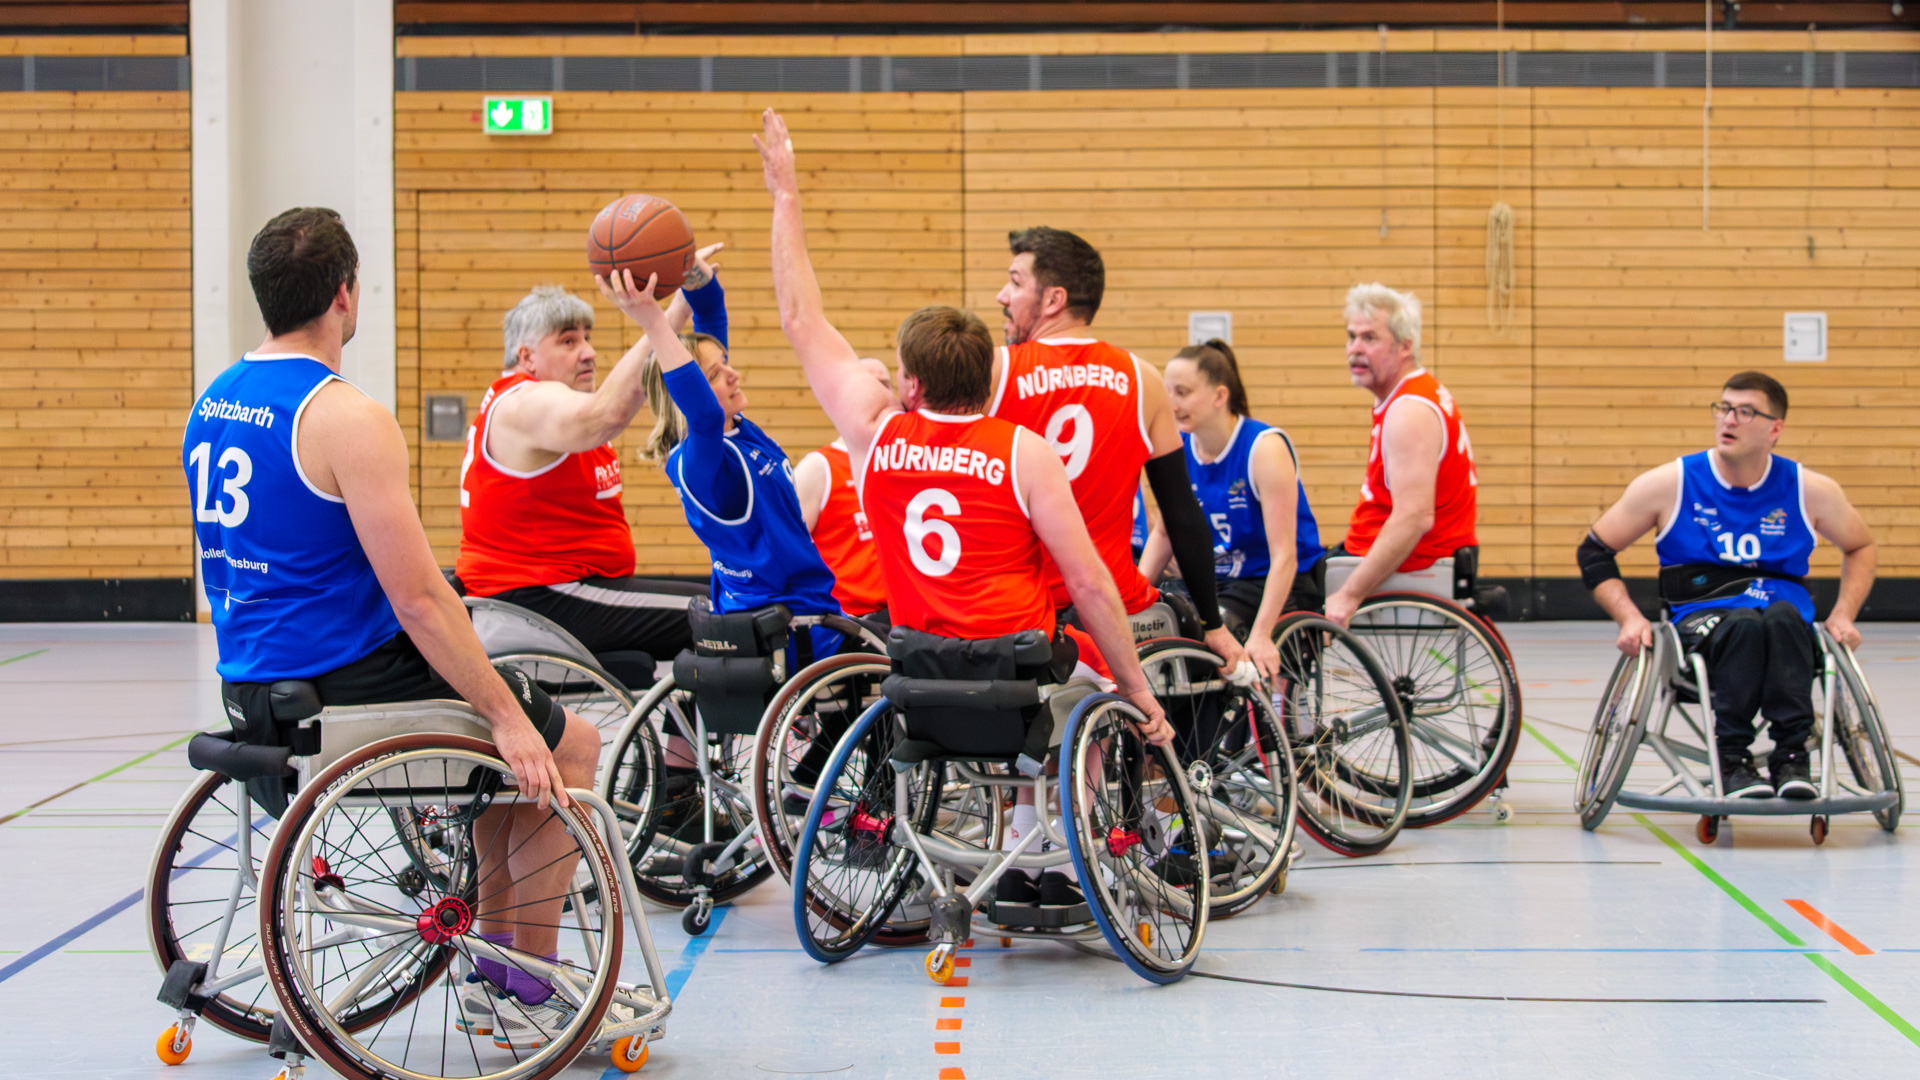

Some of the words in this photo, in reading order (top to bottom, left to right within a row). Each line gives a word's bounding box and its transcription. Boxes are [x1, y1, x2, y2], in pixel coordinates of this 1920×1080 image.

[1016, 362, 1130, 400] NÜRNBERG
[198, 396, 275, 429] Spitzbarth
[873, 437, 1006, 486] NÜRNBERG
[1045, 403, 1094, 482] 9
[189, 441, 253, 528] 13
[903, 487, 962, 577] 6
[1717, 532, 1761, 563] 10
